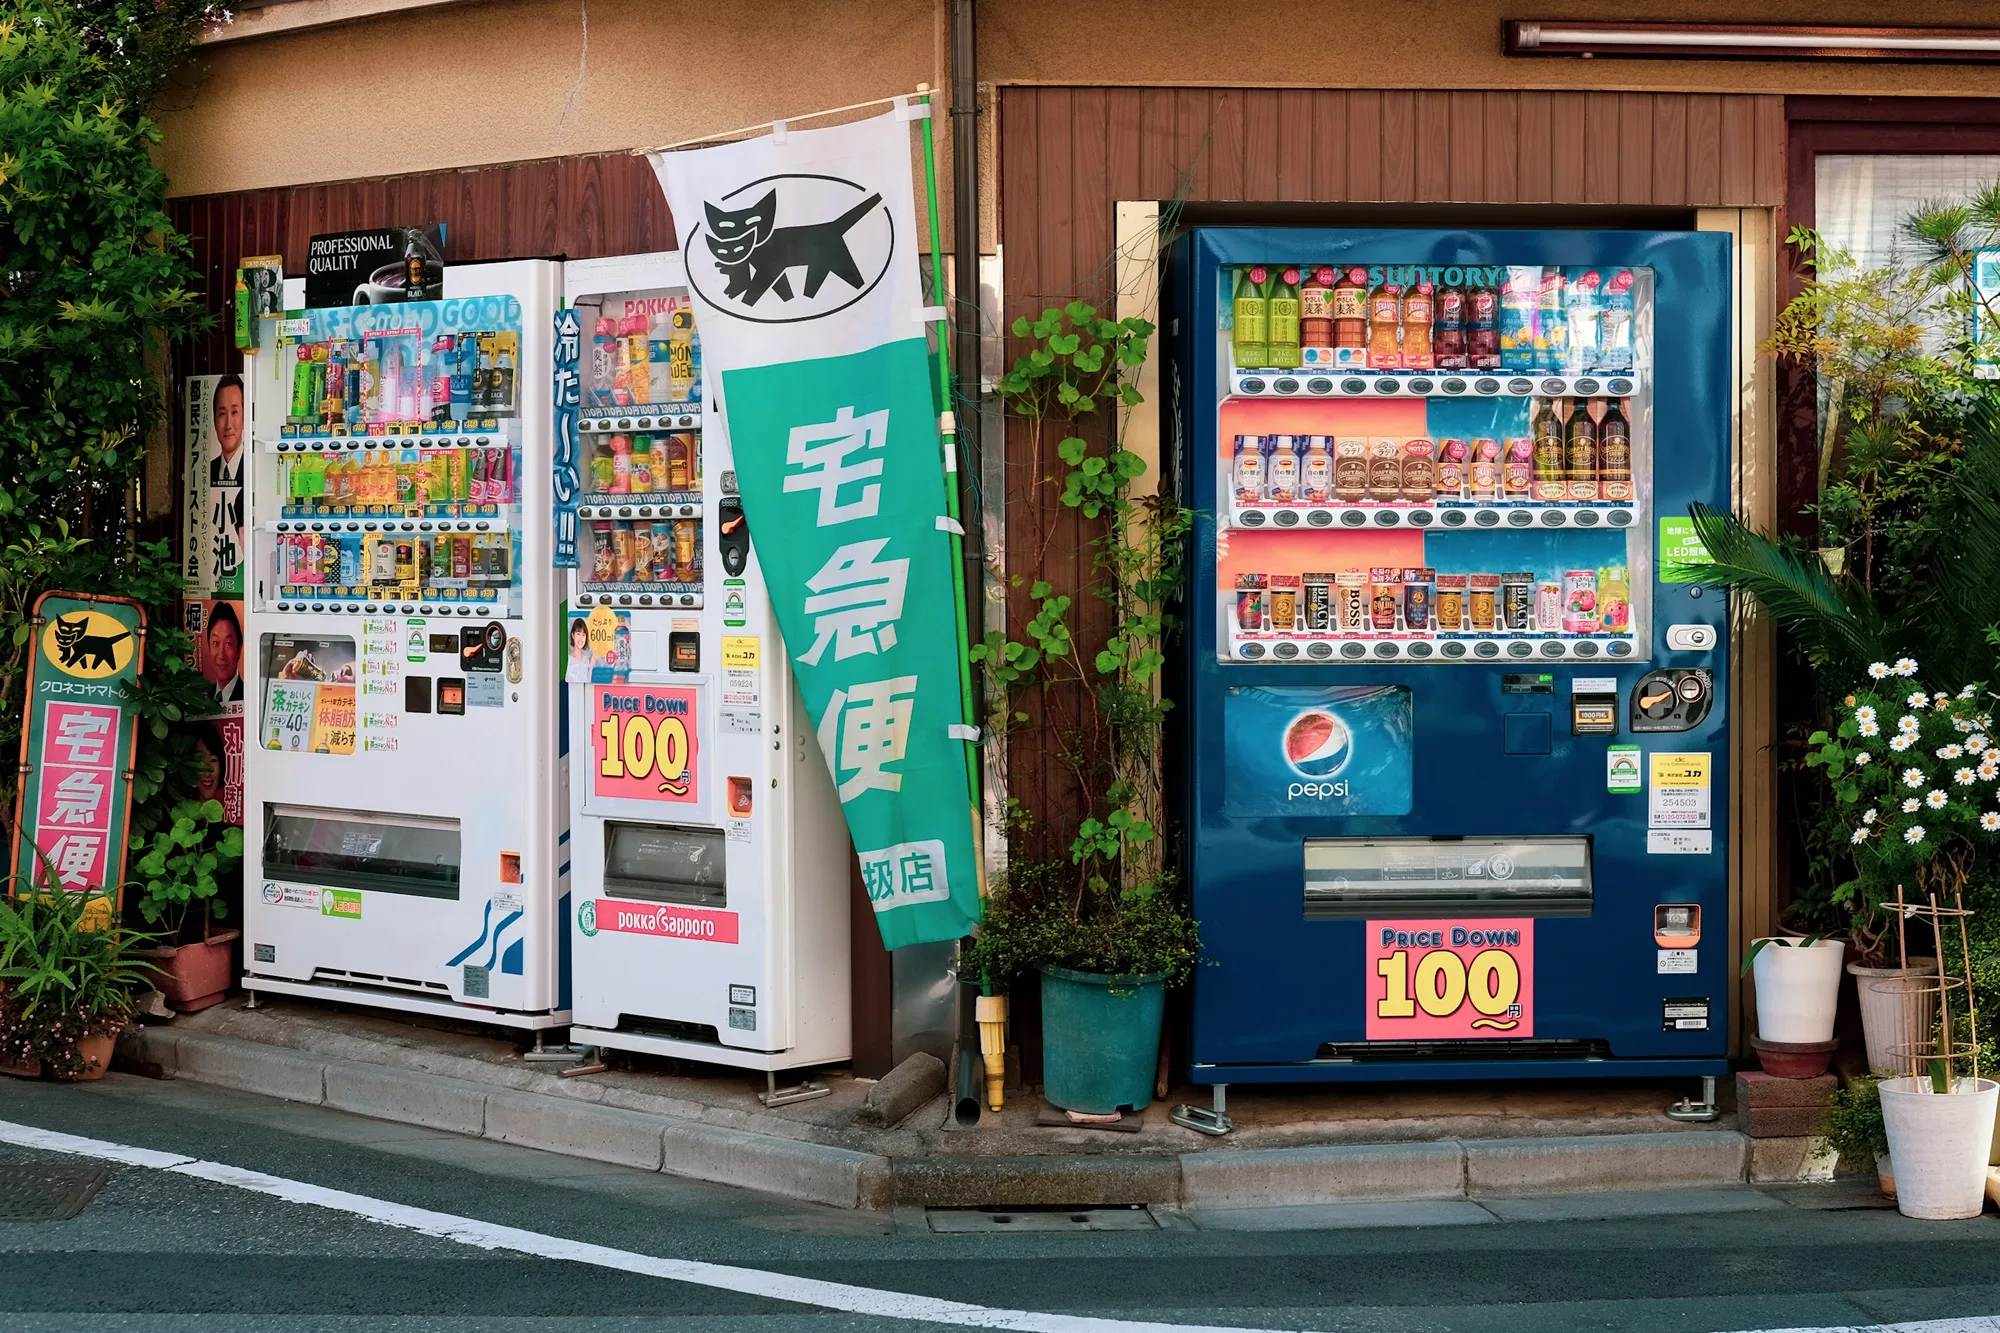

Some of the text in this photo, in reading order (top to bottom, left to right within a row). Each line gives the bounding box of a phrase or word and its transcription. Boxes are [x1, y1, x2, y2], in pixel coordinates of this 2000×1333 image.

[311, 235, 393, 256] PROFESSIONAL
[309, 255, 358, 274] QUALITY
[1369, 265, 1500, 286] SUNTORY
[442, 299, 521, 328] GOOD
[624, 296, 678, 318] POKKA
[1305, 304, 1323, 314] 麦茶
[1337, 304, 1355, 314] 麦茶
[660, 404, 679, 414] 130円
[681, 403, 700, 412] 100円
[188, 379, 201, 577] 都民ファーストの会
[642, 493, 661, 503] 110円
[661, 493, 681, 503] 110円
[682, 493, 702, 503] 110円
[212, 491, 238, 577] 小池
[214, 580, 235, 590] ゆりこ
[1404, 570, 1415, 582] 新
[783, 406, 918, 803] 宅急便
[1317, 588, 1328, 628] BLACK
[1350, 590, 1360, 626] BOSS
[1517, 588, 1527, 628] BLACK
[592, 618, 612, 626] たっぷり
[39, 680, 129, 699] クロネコヤマトの
[730, 680, 752, 688] 059224
[272, 689, 287, 712] 茶
[290, 691, 311, 700] おいしく
[603, 692, 688, 714] PRICE DOWN
[286, 701, 310, 713] カテキン
[286, 714, 302, 732] 40
[223, 723, 243, 823] 丸川珠代
[46, 710, 111, 887] 宅急便
[1288, 779, 1348, 800] pepsi
[1662, 799, 1697, 807] 254503
[1381, 926, 1520, 947] PRICE DOWN
